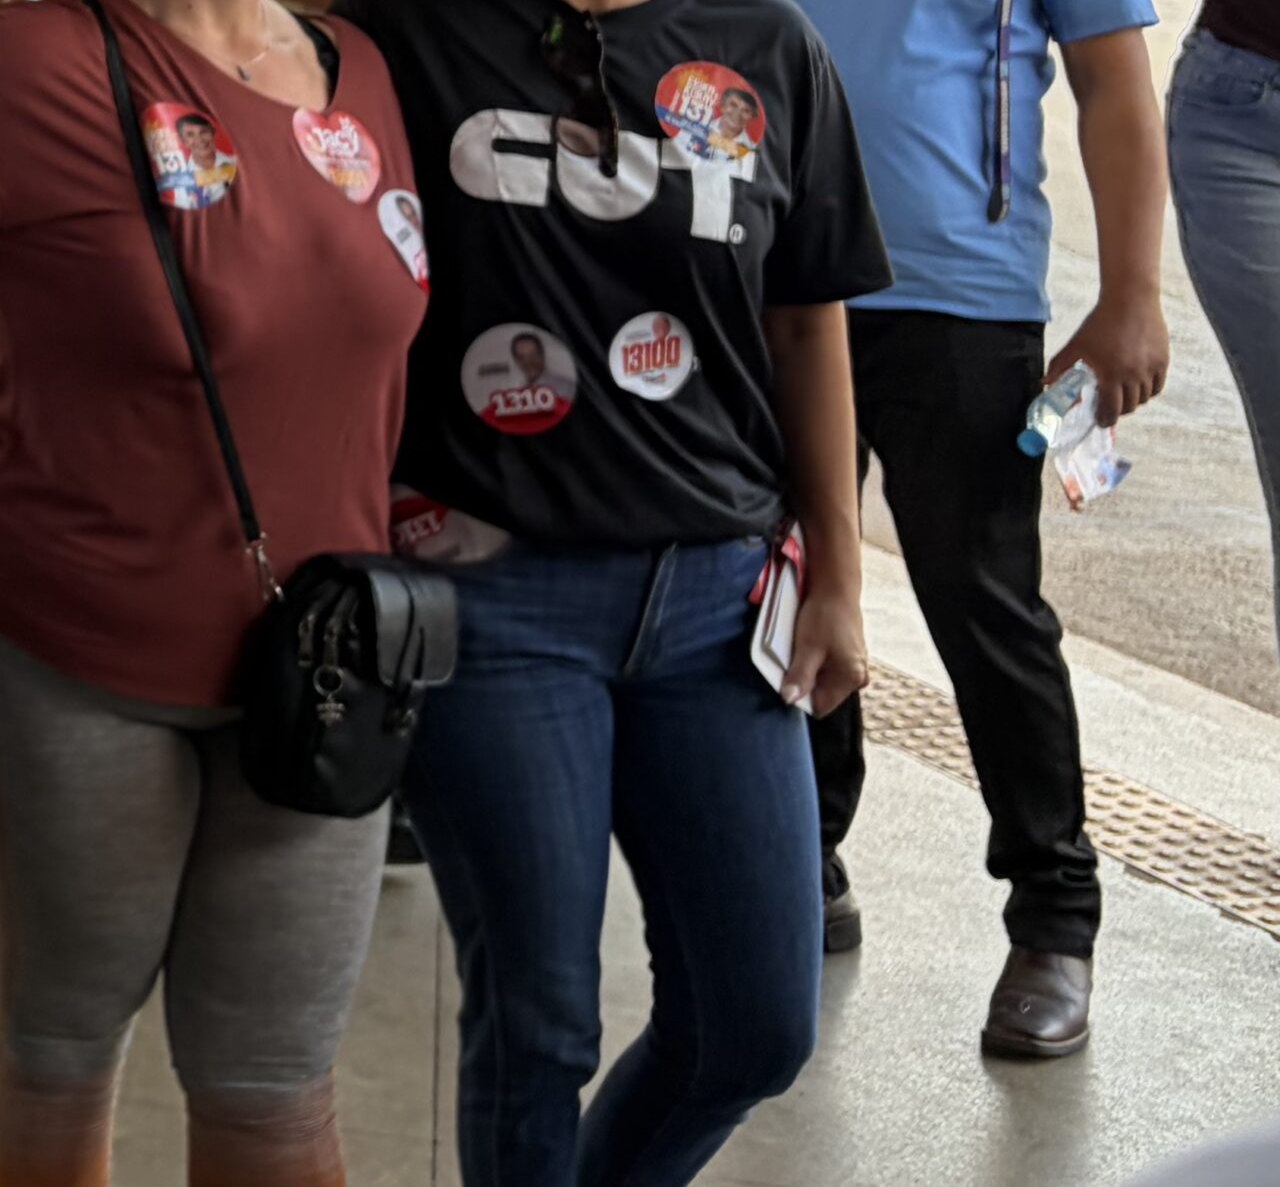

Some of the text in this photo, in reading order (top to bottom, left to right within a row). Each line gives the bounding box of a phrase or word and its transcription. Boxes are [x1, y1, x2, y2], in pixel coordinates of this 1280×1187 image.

[450, 108, 756, 242] CUT
[622, 335, 682, 376] 13100
[491, 387, 555, 417] 1310
